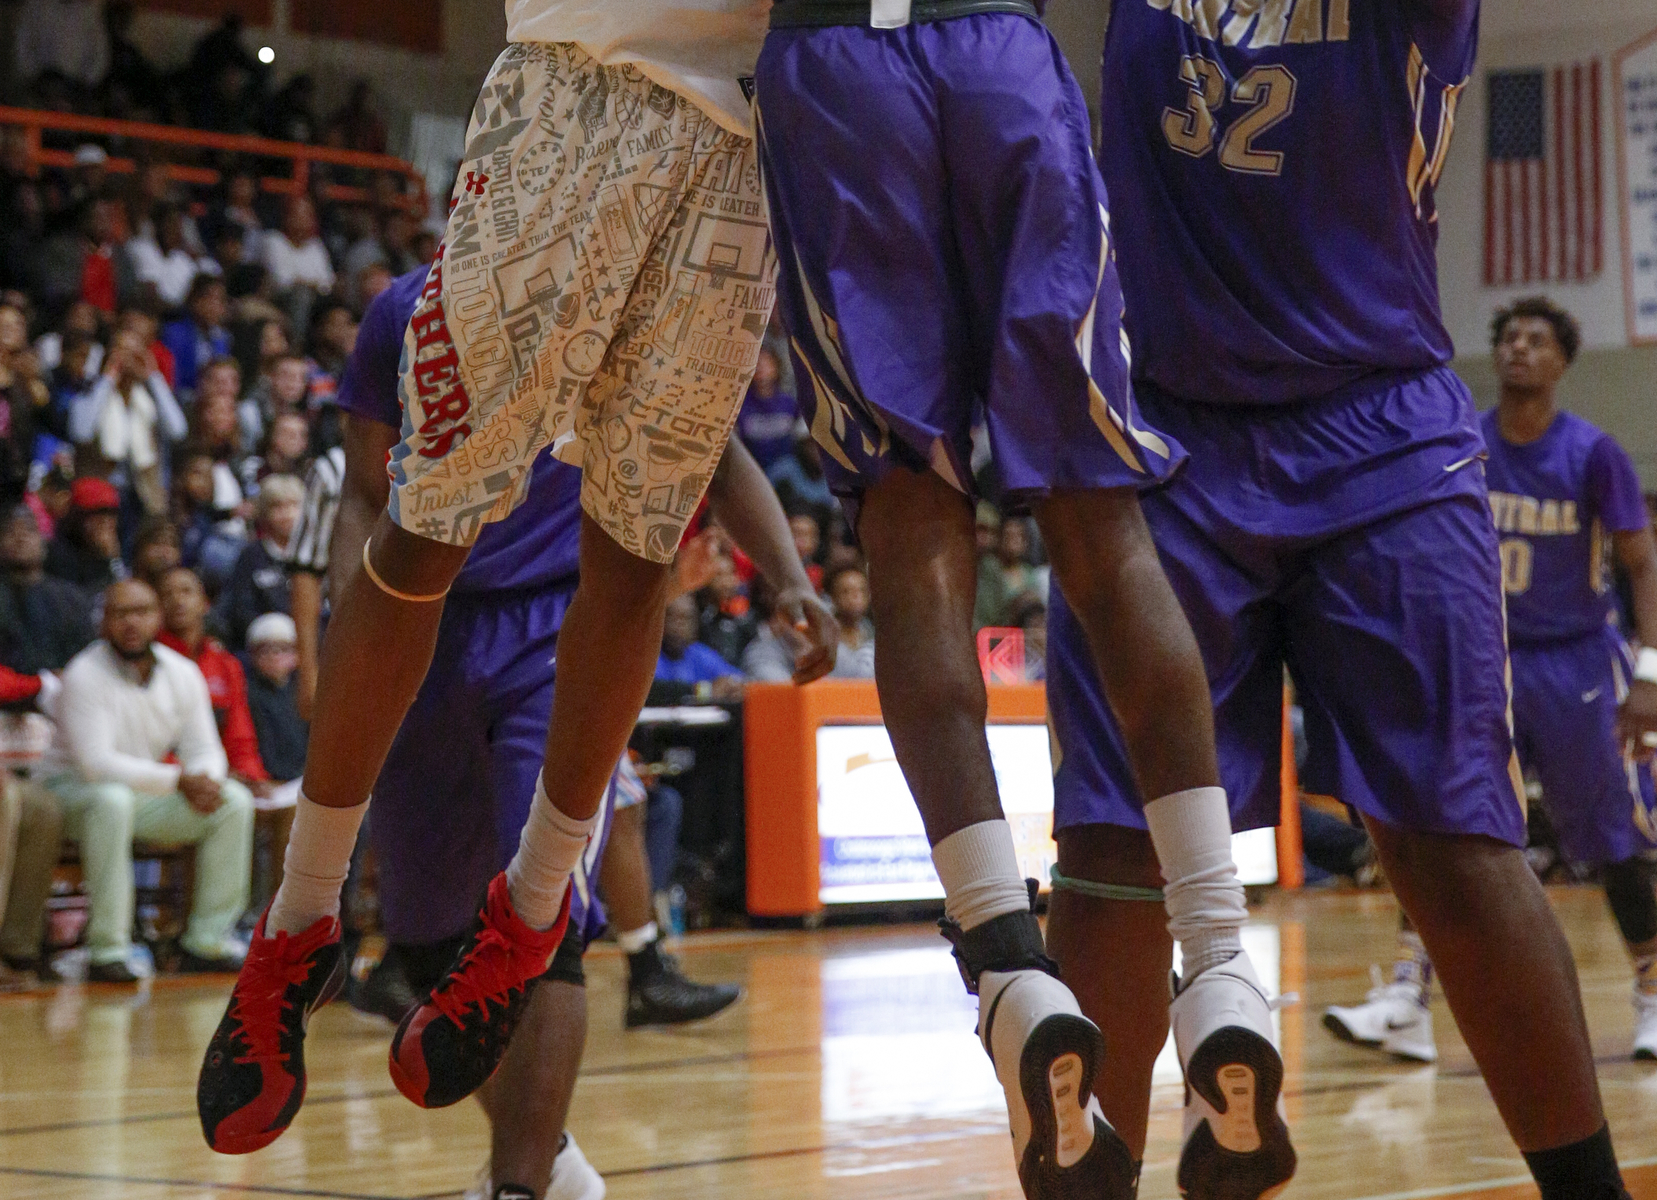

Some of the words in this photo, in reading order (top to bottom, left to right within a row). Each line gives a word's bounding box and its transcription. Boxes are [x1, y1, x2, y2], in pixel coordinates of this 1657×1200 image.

[1161, 53, 1298, 177] 32
[626, 123, 674, 158] FAMILY
[701, 194, 717, 209] IS
[450, 263, 460, 275] NO
[461, 257, 479, 271] ONE
[480, 254, 490, 266] IS
[551, 221, 568, 236] THE
[583, 336, 597, 346] 24
[684, 356, 739, 381] TRADITION
[405, 480, 479, 516] Trust
